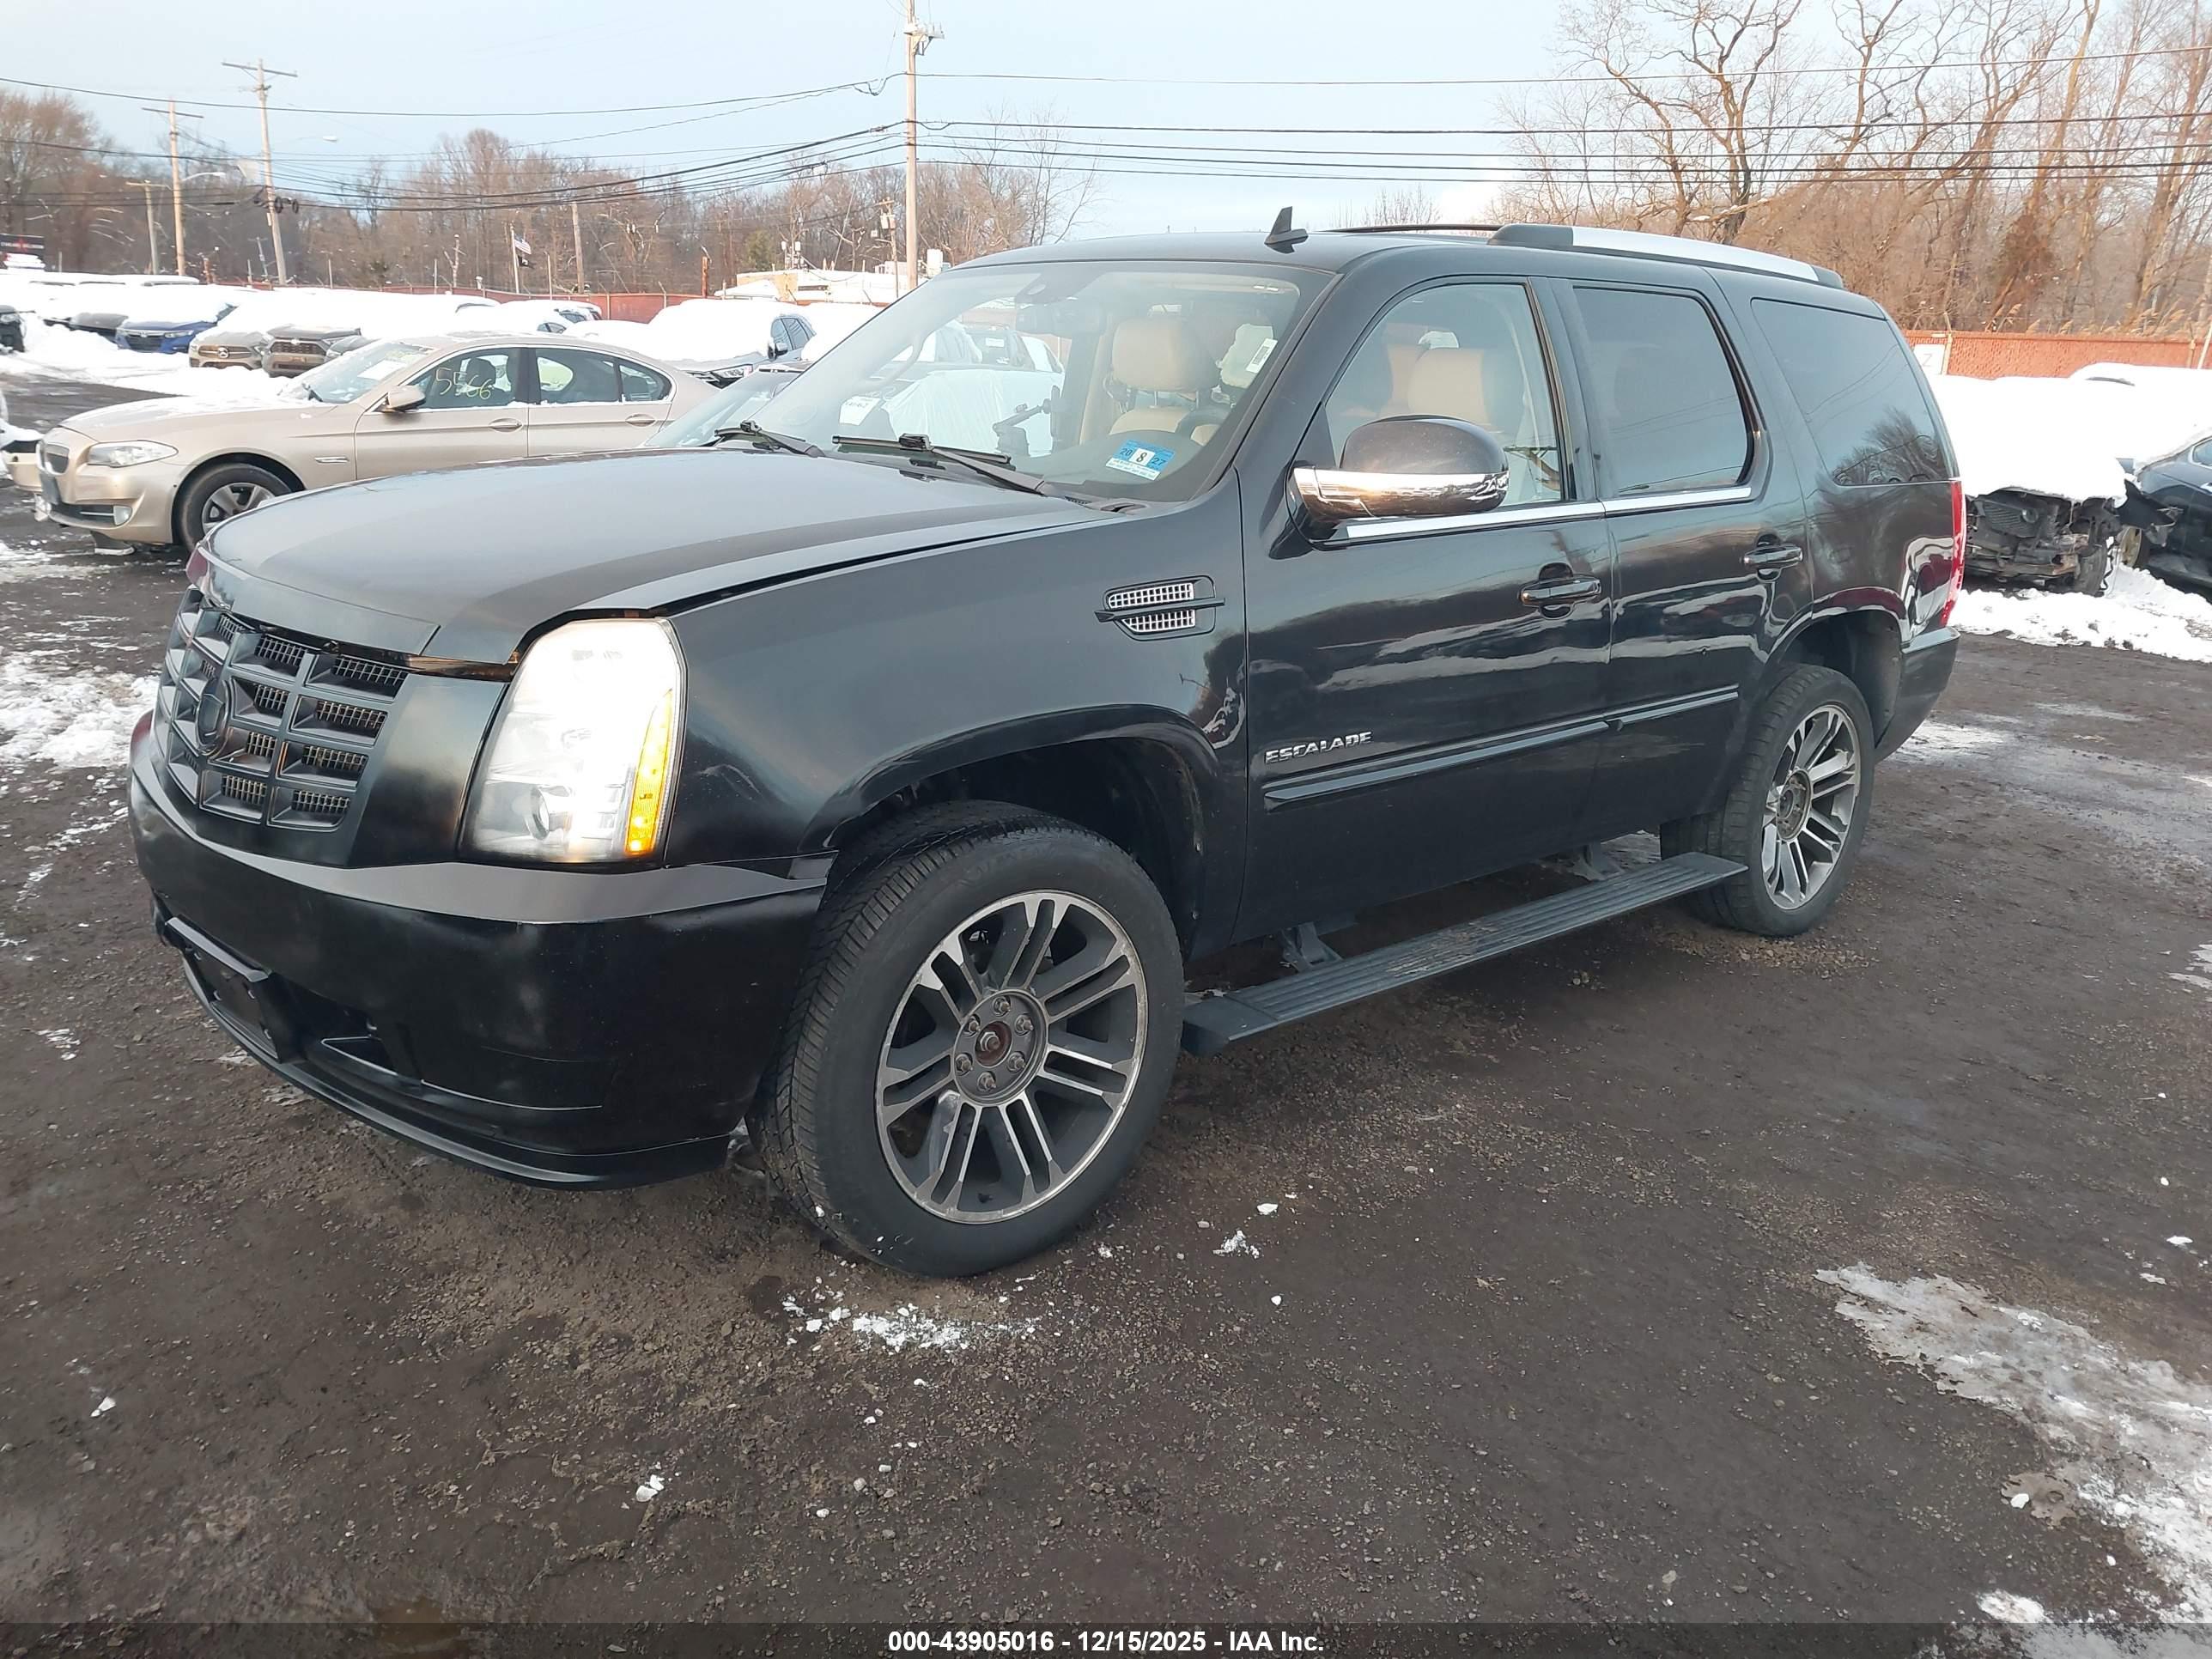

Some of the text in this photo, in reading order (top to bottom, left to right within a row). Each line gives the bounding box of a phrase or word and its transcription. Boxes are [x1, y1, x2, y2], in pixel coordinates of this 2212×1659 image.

[436, 367, 492, 400] 5566
[1120, 447, 1166, 466] 20 8 27
[1265, 731, 1372, 763] ESCALADE
